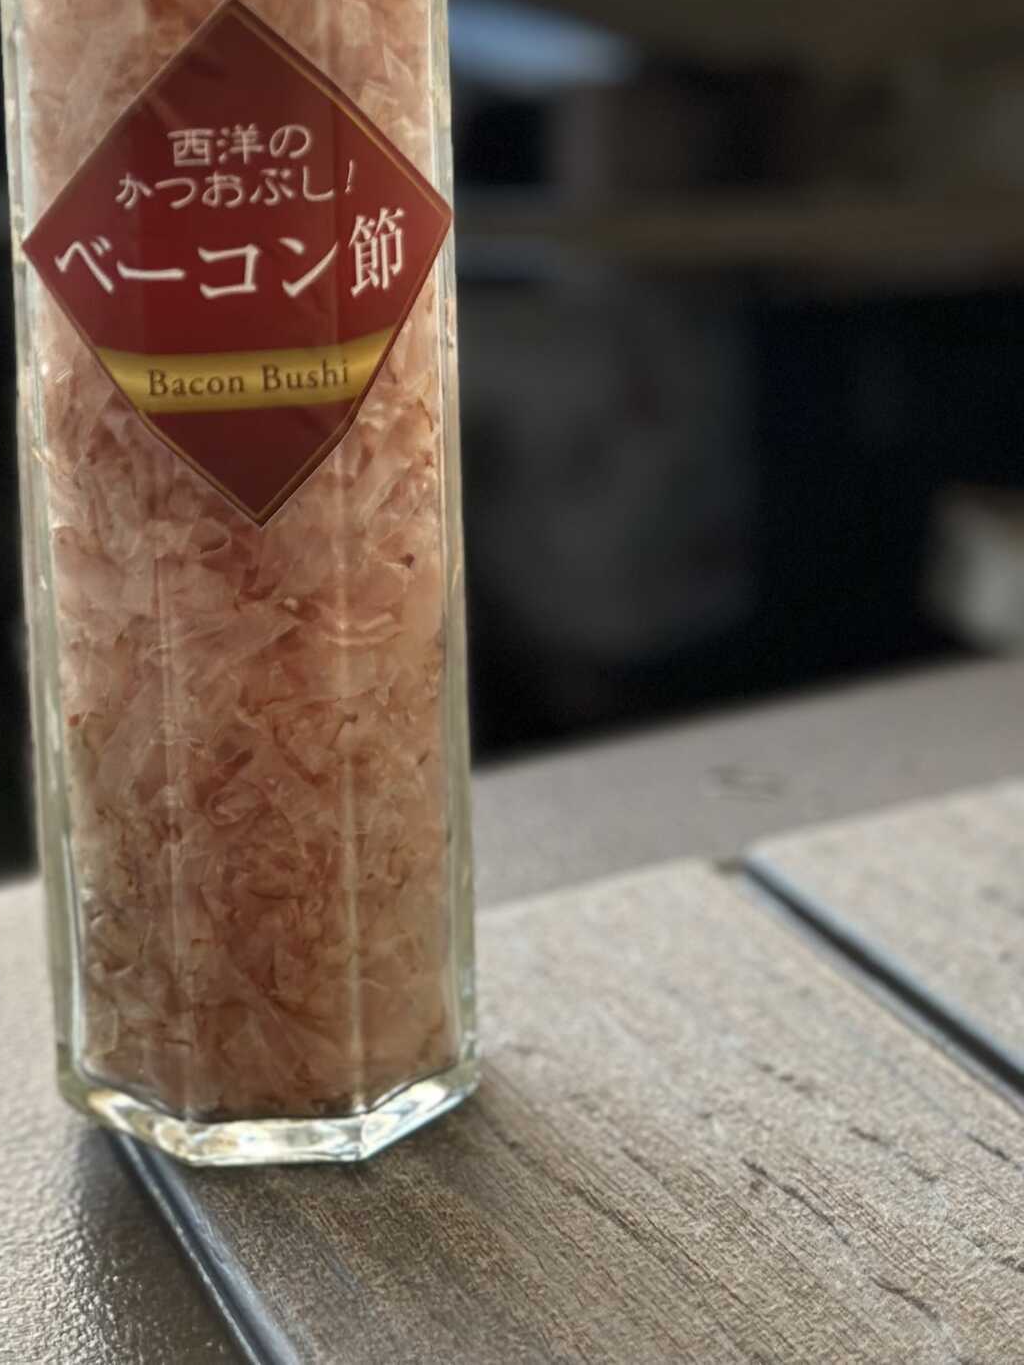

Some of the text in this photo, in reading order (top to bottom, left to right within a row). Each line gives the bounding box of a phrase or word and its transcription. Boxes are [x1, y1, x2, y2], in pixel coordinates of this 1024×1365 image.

[167, 122, 313, 167] 西洋の
[54, 206, 406, 298] ベーコン節
[147, 358, 350, 398] Bacon Bushi
